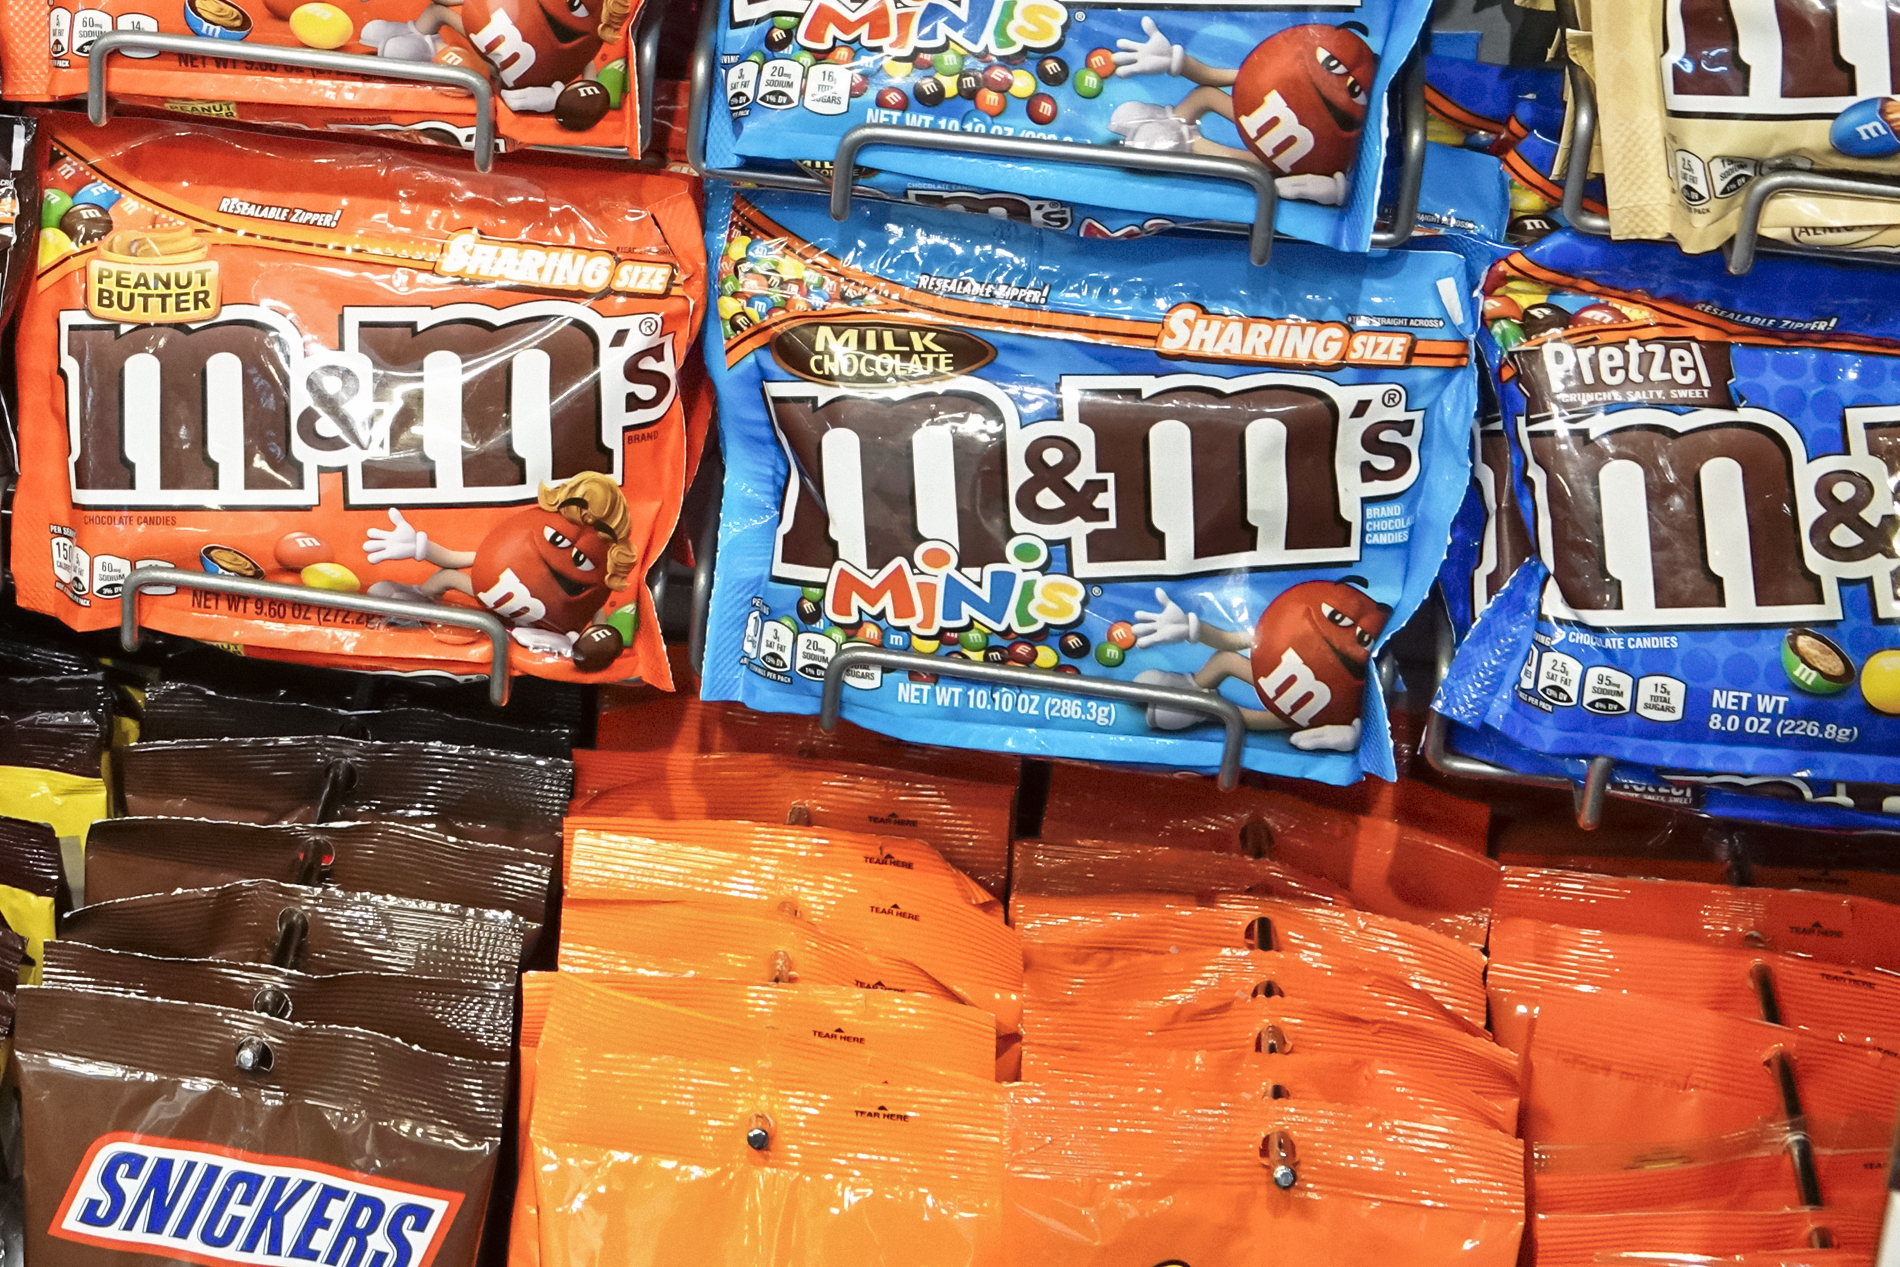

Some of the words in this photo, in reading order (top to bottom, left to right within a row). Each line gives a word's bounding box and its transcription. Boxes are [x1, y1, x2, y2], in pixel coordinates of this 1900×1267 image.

[442, 235, 611, 289] SHARING
[616, 265, 670, 291] SIZE
[97, 267, 211, 291] PEANUT
[98, 289, 211, 313] BUTTER
[815, 326, 943, 353] MILK
[1162, 312, 1343, 358] SHARING
[1351, 335, 1409, 361] SIZE
[809, 351, 954, 376] CHOCOLATE
[1546, 343, 1708, 390] Pretzel
[1669, 389, 1709, 399] SWEET
[191, 589, 220, 609] NET
[224, 592, 249, 612] WT
[254, 596, 287, 619] 9.60
[1568, 631, 1625, 648] CHOCOLATE
[1627, 635, 1678, 648] CANDIES
[898, 683, 927, 704] NET
[930, 686, 960, 706] WT
[966, 688, 1015, 711] 10.10
[1016, 693, 1039, 715] OZ
[1044, 699, 1116, 726] (286.3g)
[1712, 690, 1751, 710] NET
[1755, 693, 1789, 715] WT
[1709, 715, 1740, 732] 8.0
[1745, 716, 1771, 734] OZ
[1776, 718, 1858, 741] (226.8g)
[81, 1147, 436, 1267] SNICKERS
